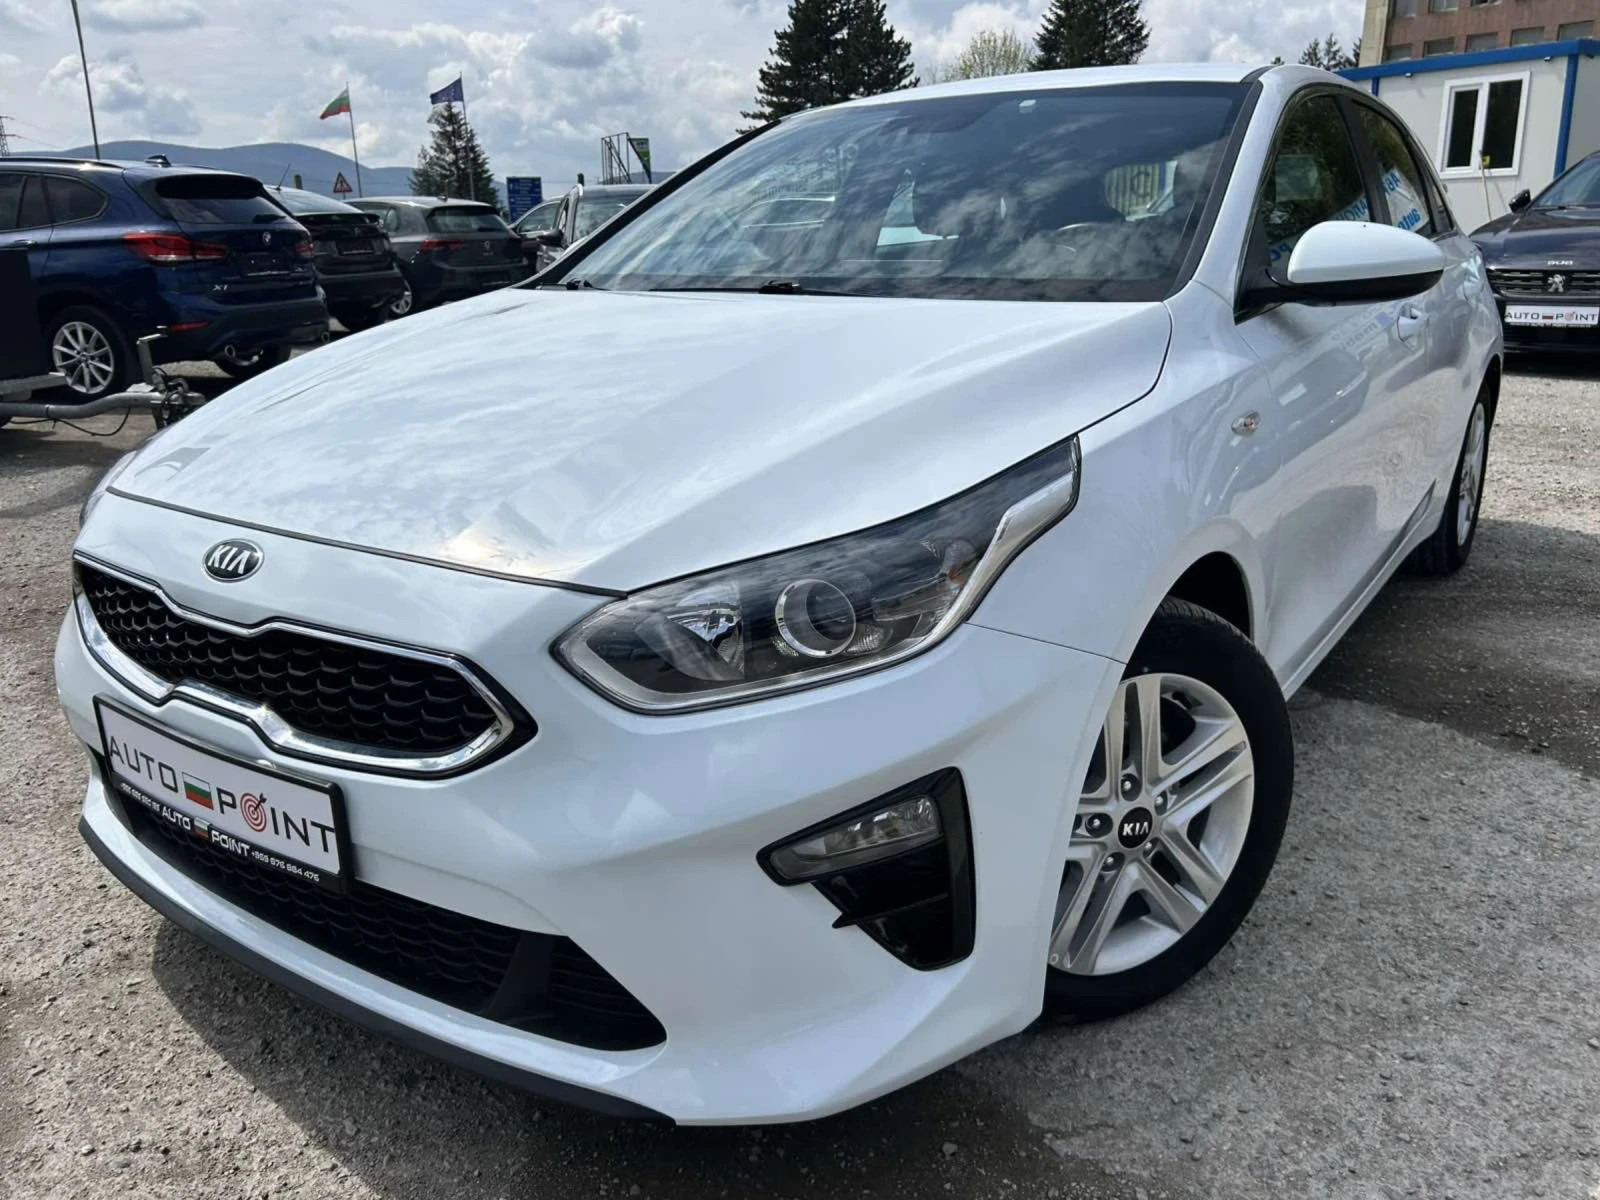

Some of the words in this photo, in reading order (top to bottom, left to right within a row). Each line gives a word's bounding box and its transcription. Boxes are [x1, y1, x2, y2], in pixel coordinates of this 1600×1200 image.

[212, 284, 229, 292] X1
[1506, 312, 1540, 320] AUTO
[207, 545, 251, 575] KIA
[109, 735, 178, 793] AUTO
[216, 787, 335, 853] POINT
[162, 806, 191, 830] AUTO
[211, 830, 250, 857] POINT
[1122, 821, 1149, 836] KIA
